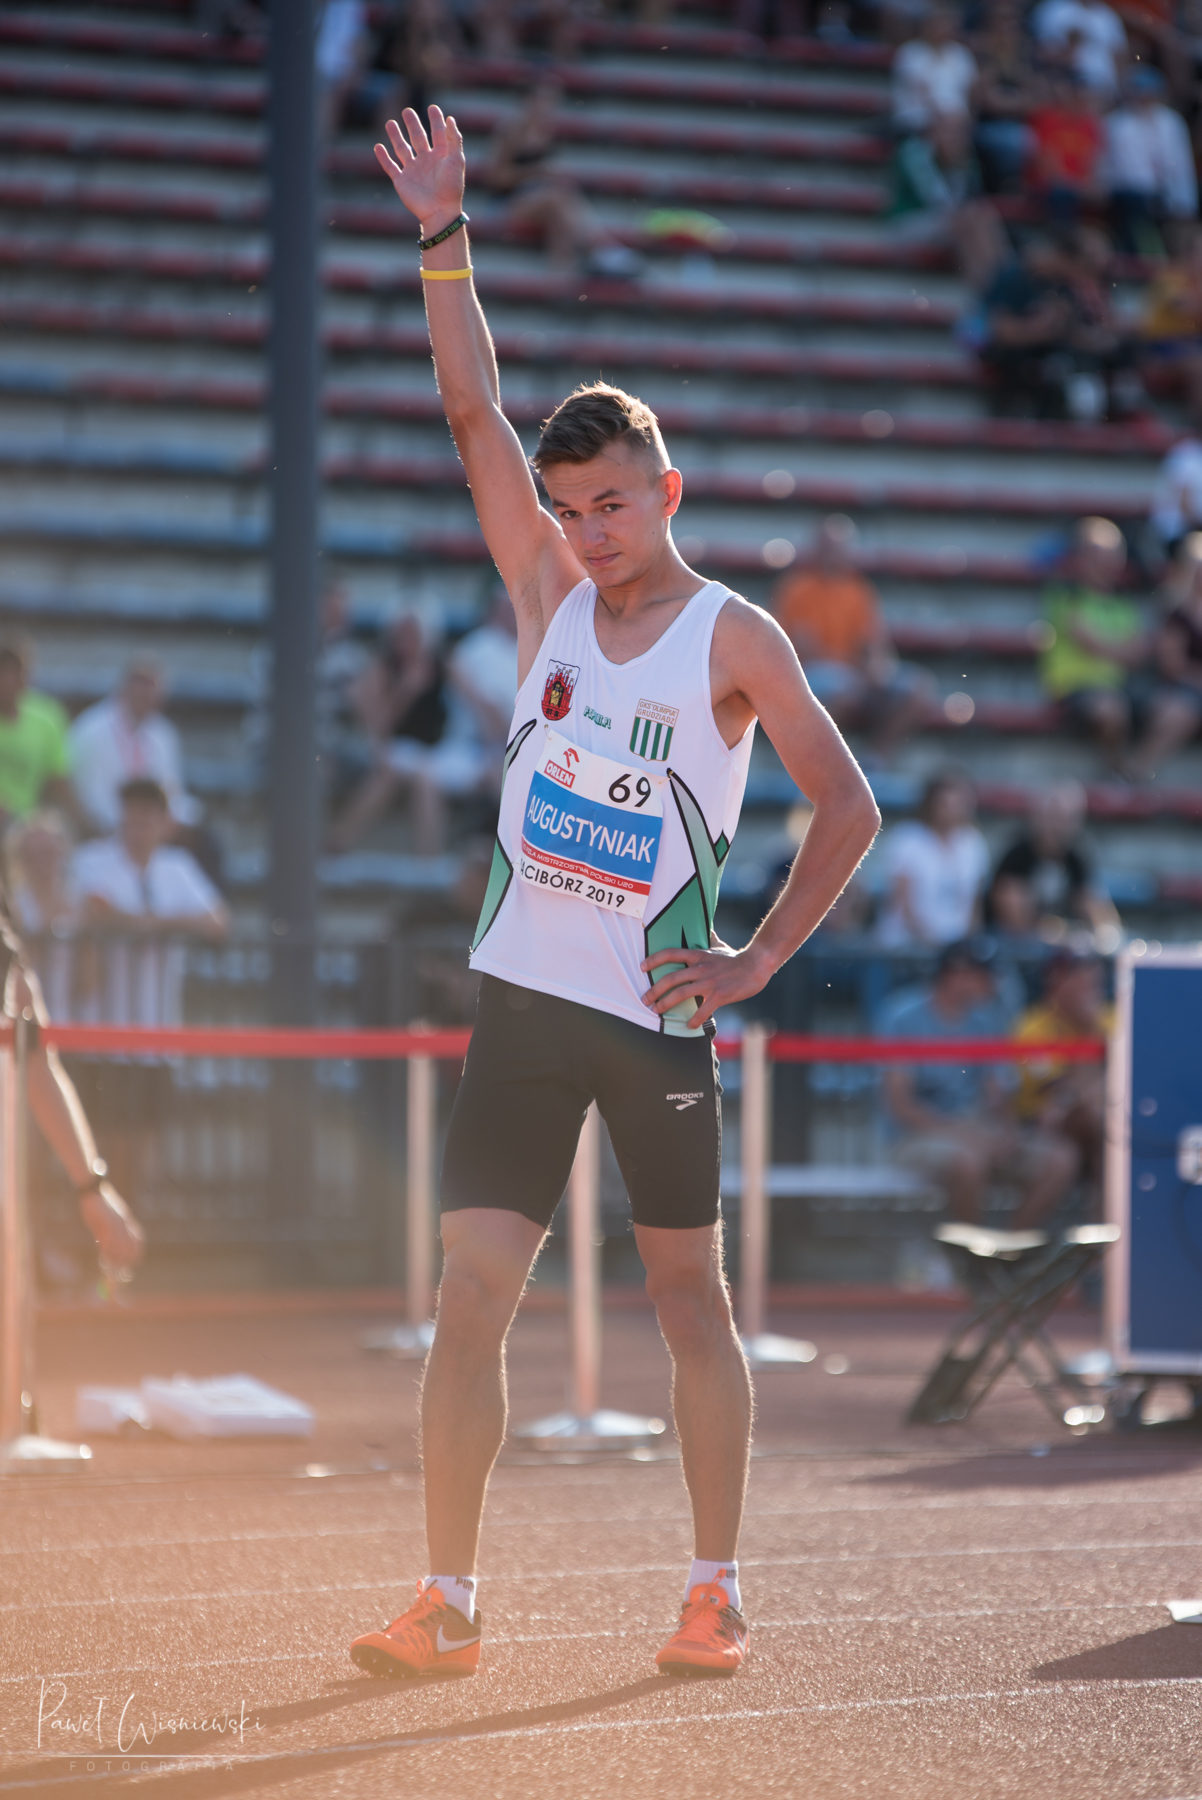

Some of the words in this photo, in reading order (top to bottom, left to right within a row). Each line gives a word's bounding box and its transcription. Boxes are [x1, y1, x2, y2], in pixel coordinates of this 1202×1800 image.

[639, 701, 651, 710] GKS
[546, 763, 573, 785] ORLEN
[608, 773, 652, 808] 69
[527, 794, 656, 864] AUGUSTYNIAK
[520, 858, 584, 894] ACIBÓRZ
[585, 885, 626, 908] 2019
[536, 853, 590, 875] MISTRZOSTWA
[589, 871, 617, 885] POLSKI
[617, 880, 634, 890] U20
[666, 1092, 704, 1101] BROOKS
